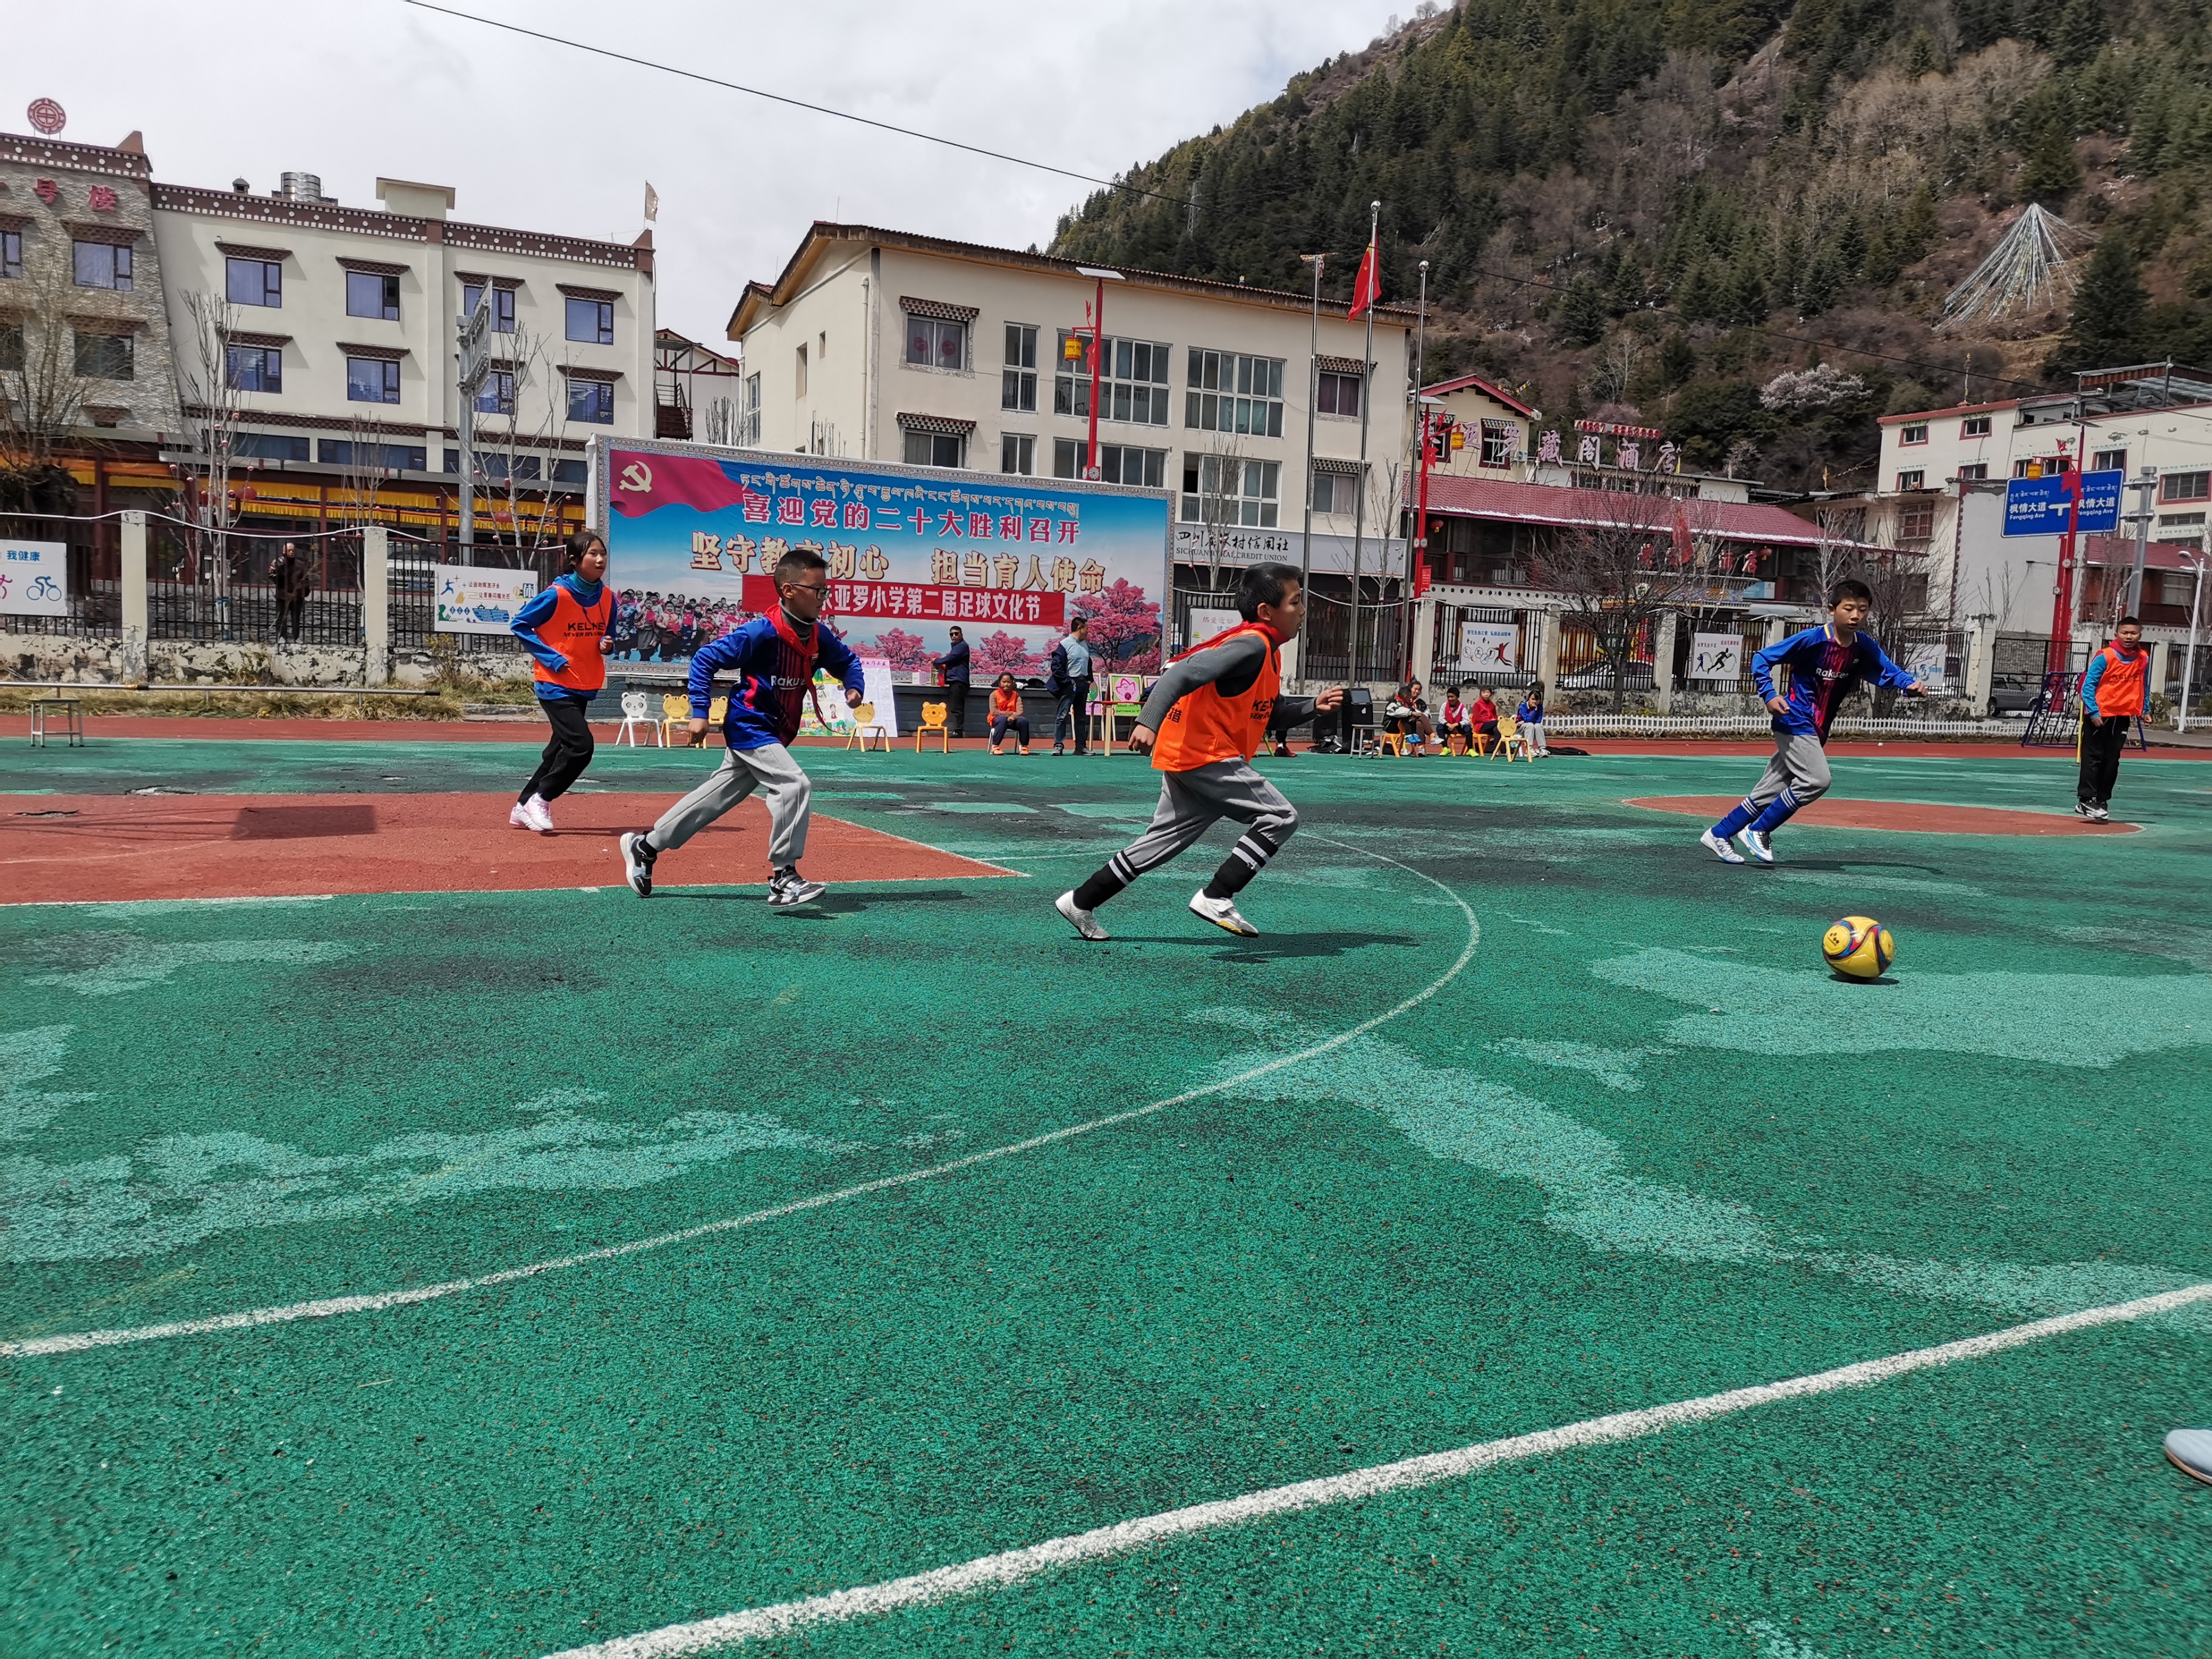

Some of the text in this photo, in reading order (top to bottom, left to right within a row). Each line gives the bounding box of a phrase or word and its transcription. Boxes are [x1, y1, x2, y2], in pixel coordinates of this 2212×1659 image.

[0, 176, 117, 212] 号楼
[742, 493, 1080, 544] 喜迎党的二十大胜利召开
[2009, 502, 2046, 514] 枫情大道
[7, 550, 40, 561] 我健康
[1211, 549, 1235, 558] RRAL
[1236, 551, 1262, 560] CREDIT
[1264, 553, 1287, 561] UNION
[931, 548, 1105, 593] 担当育人使命
